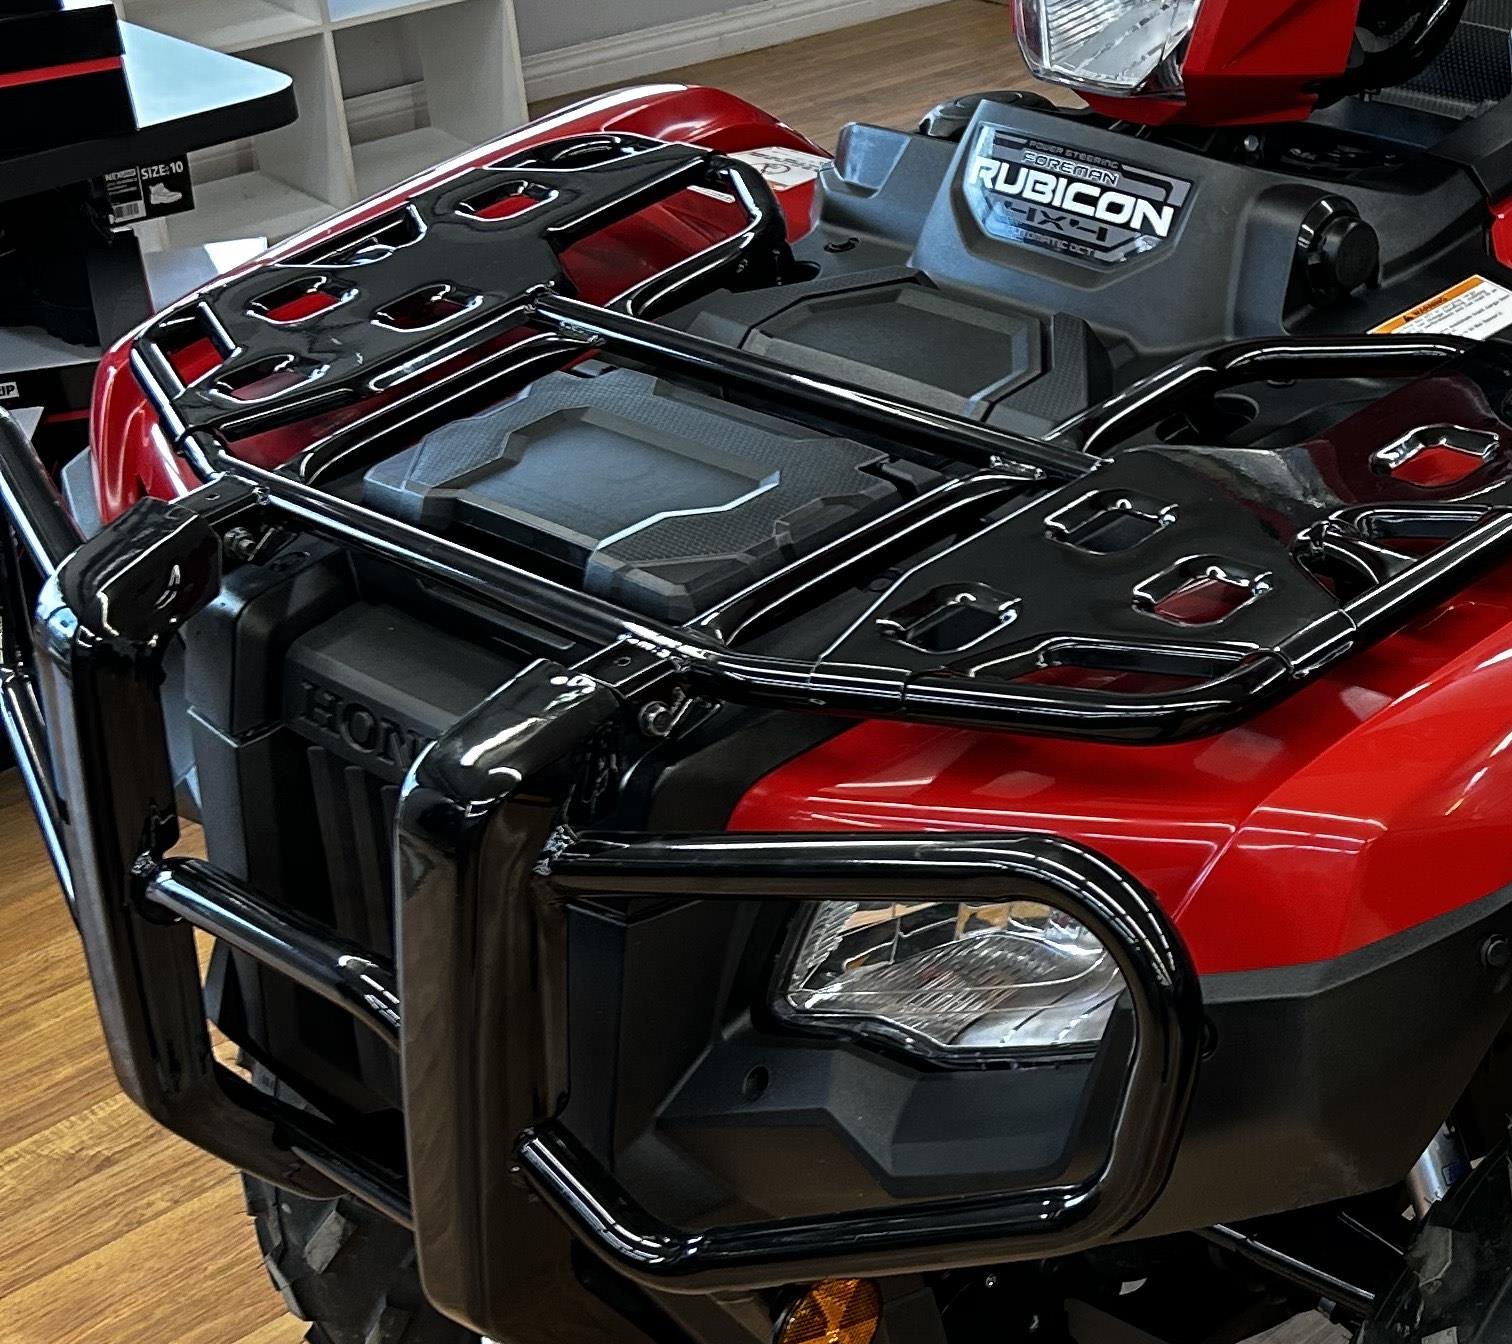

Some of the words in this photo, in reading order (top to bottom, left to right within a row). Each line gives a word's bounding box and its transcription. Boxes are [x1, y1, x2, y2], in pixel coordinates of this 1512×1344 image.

[1021, 150, 1121, 187] FOREMAN
[1028, 140, 1064, 156] POWER
[1064, 148, 1120, 170] STEERING
[968, 156, 1175, 238] RUBICON
[300, 679, 432, 772] HON
